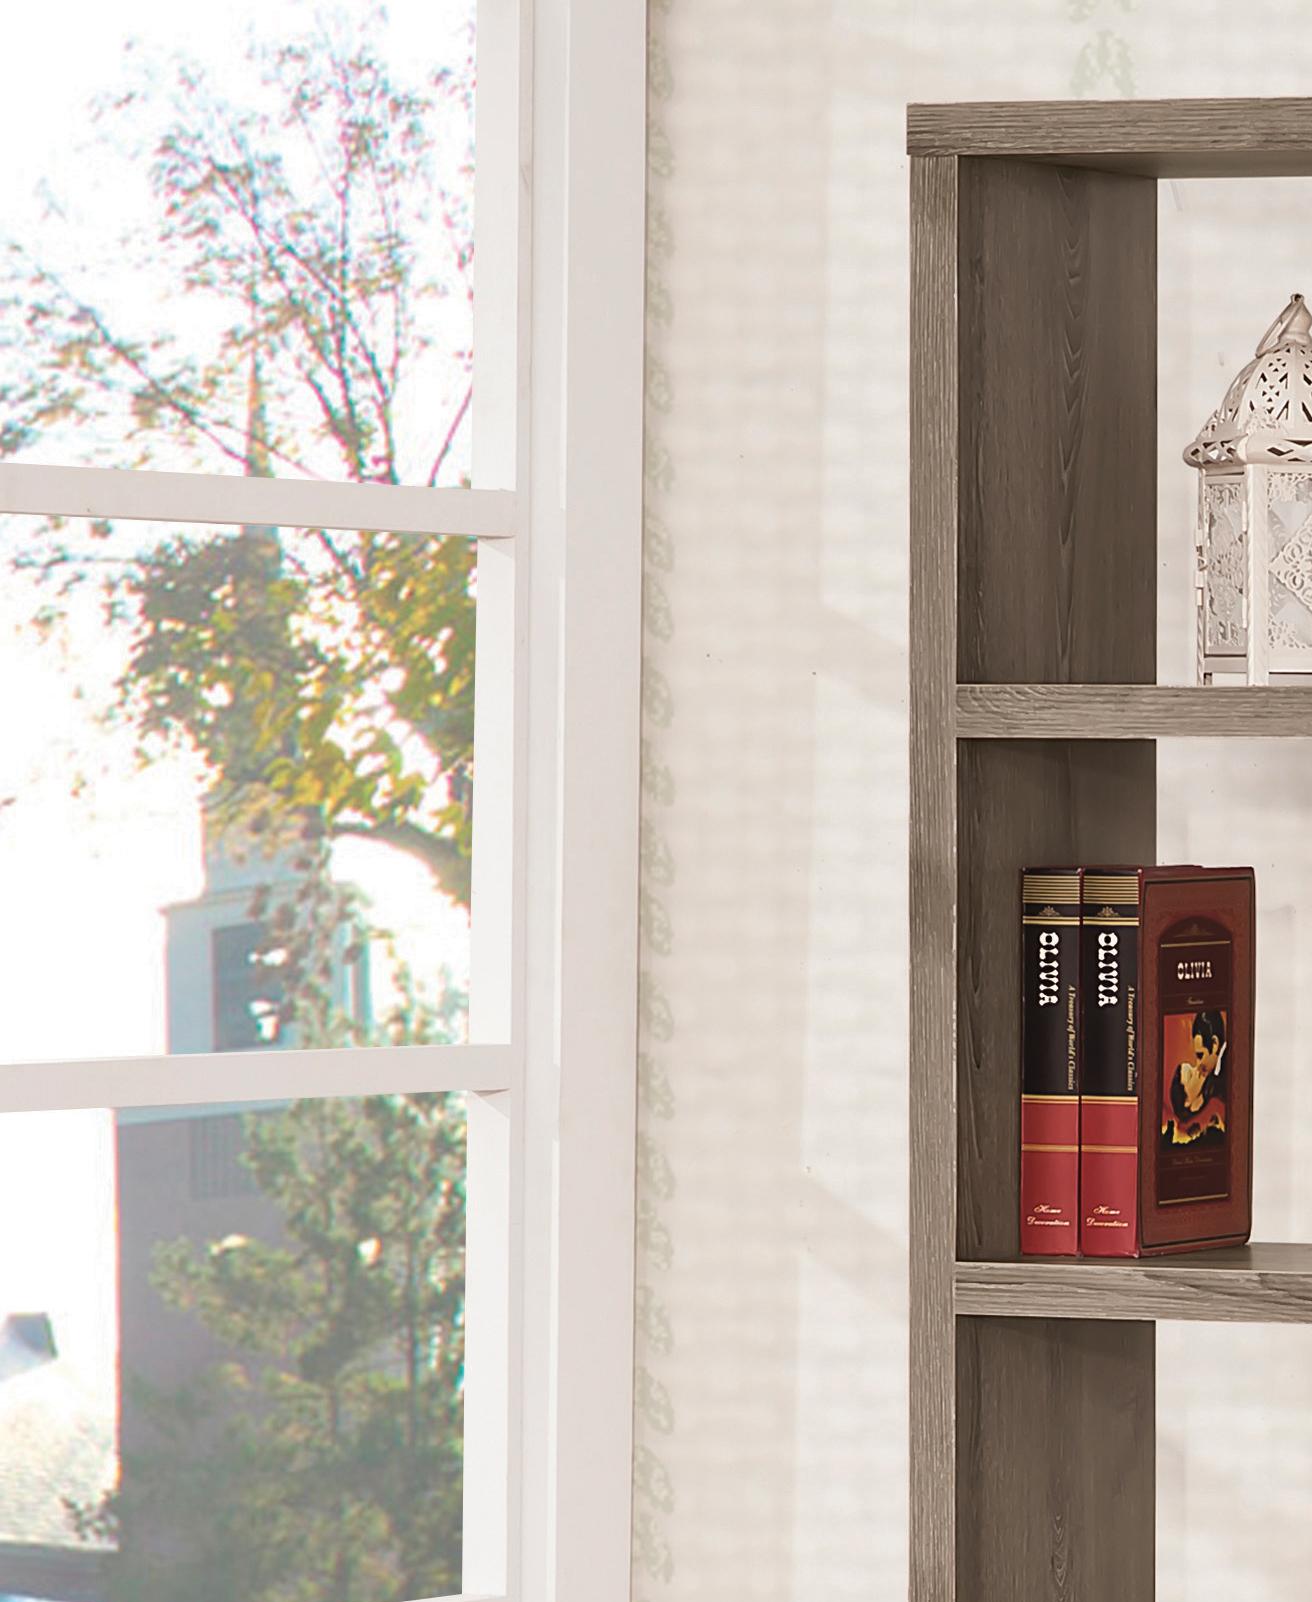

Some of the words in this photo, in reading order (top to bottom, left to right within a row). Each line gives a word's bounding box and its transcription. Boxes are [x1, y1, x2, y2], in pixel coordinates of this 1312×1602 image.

[1039, 931, 1059, 1006] OLIVIA
[1098, 932, 1118, 1007] OLIVIA
[1177, 961, 1212, 980] OLIVIA
